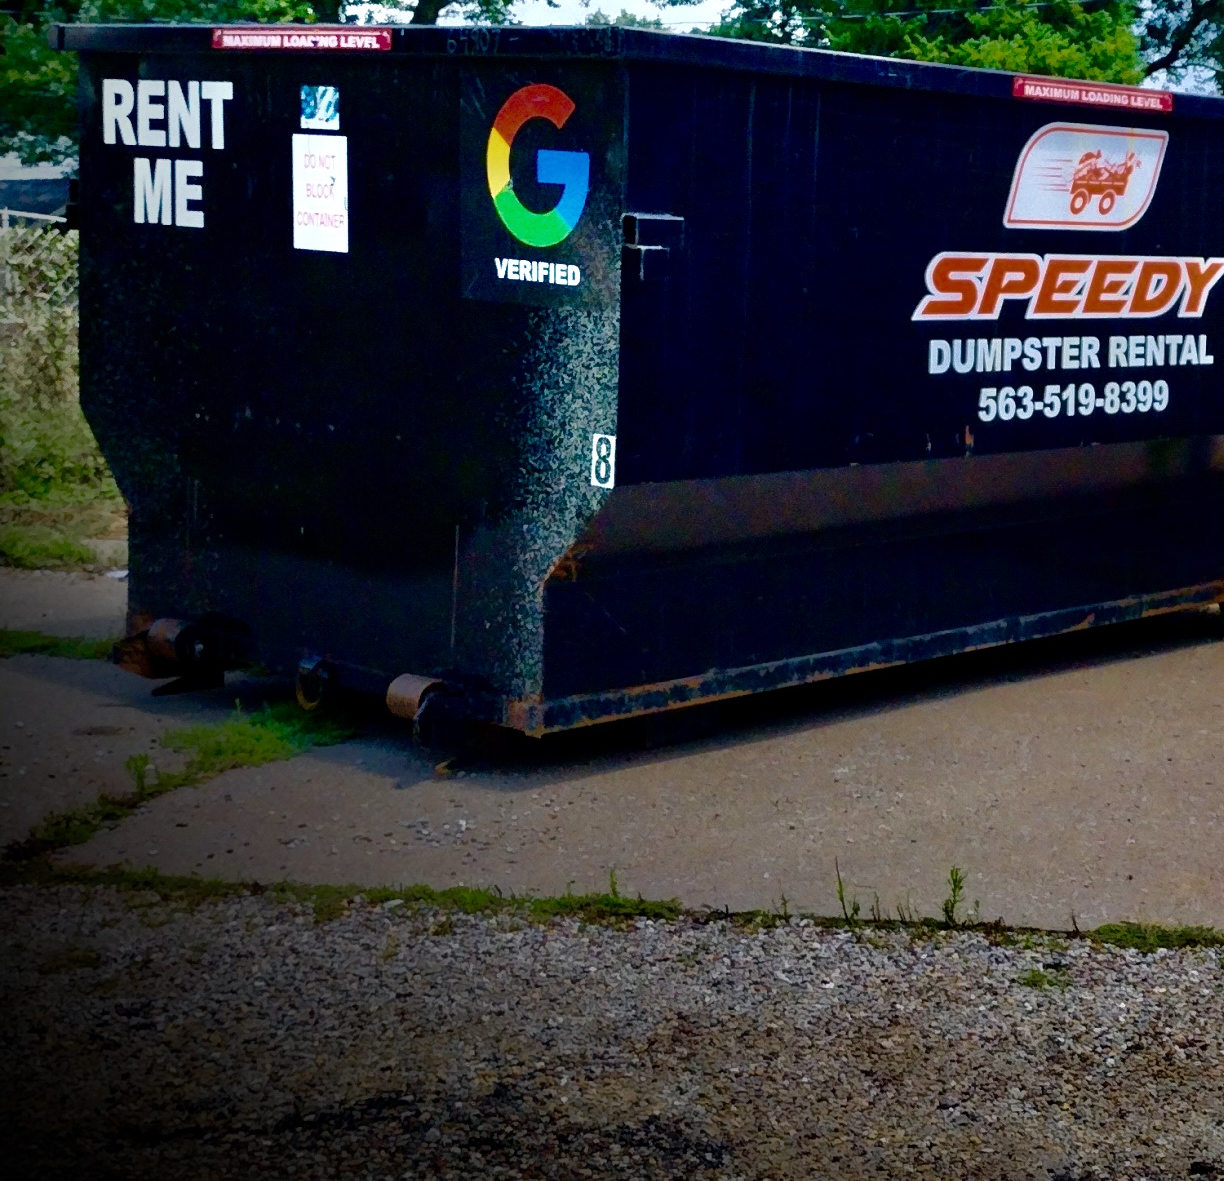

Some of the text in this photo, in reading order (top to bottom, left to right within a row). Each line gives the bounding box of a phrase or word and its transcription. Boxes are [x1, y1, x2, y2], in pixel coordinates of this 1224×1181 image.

[222, 35, 281, 48] MAXIMUM
[340, 35, 380, 49] LEVEL
[102, 78, 234, 150] RENT
[1024, 85, 1163, 109] MAXIMUM LOADING LEVEL
[304, 154, 336, 170] DO NOT
[486, 83, 590, 248] G
[133, 157, 205, 228] ME
[306, 183, 335, 199] BLOCK
[297, 211, 345, 229] CONTAINER
[494, 257, 581, 287] VERIFIED
[929, 335, 1214, 374] DUMPSTER RENTAL
[978, 380, 1169, 422] 563-519-8399
[595, 436, 612, 485] 8
